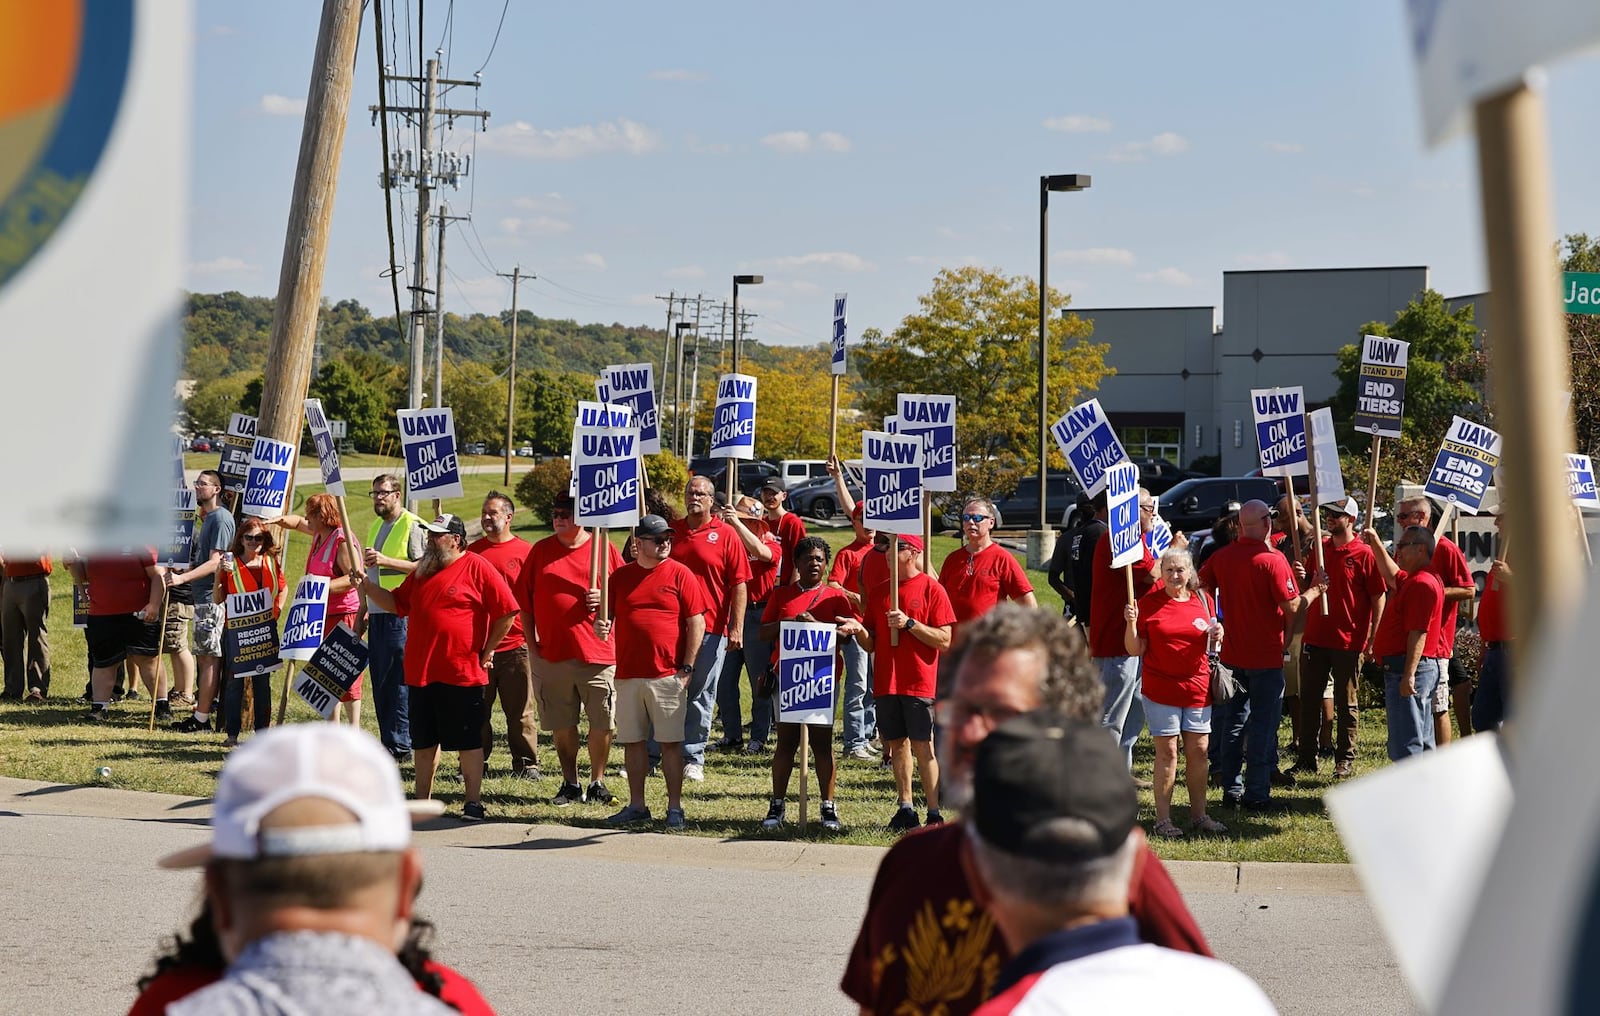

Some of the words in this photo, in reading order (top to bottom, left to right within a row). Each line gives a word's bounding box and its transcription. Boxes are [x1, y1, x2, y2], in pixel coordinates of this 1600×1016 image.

[1369, 340, 1400, 364] UAW
[611, 370, 648, 391] UAW
[1362, 366, 1387, 376] STAND
[719, 380, 752, 399] UAW
[1364, 381, 1395, 398] END
[721, 404, 739, 424] ON
[904, 400, 950, 423] UAW
[1256, 394, 1298, 415] UAW
[1360, 396, 1400, 414] TIERS
[237, 418, 256, 436] UA
[402, 414, 447, 436] UAW
[582, 408, 628, 428] UAW
[1056, 403, 1097, 444] UAW
[711, 418, 752, 448] STRIKE
[1269, 420, 1288, 442] ON
[1458, 422, 1497, 450] UAW
[229, 438, 254, 448] STAN
[254, 440, 292, 466] UAW
[418, 442, 437, 464] ON
[582, 435, 634, 456] UAW
[868, 438, 917, 464] UAW
[1080, 435, 1098, 460] ON
[1261, 432, 1306, 467] STRIKE
[1446, 442, 1479, 458] STAND
[1482, 453, 1494, 464] UP
[230, 450, 252, 464] EN
[1084, 441, 1120, 484] STRIKE
[1446, 456, 1483, 478] END
[222, 461, 247, 476] TIE
[256, 470, 275, 486] ON
[410, 454, 456, 489] STRIKE
[595, 464, 618, 488] ON
[880, 471, 900, 494] ON
[1109, 465, 1136, 497] UAW
[1435, 468, 1484, 494] TIERS
[246, 488, 284, 506] STRIKE
[580, 478, 636, 514] STRIKE
[866, 487, 919, 517] STRIKE
[1118, 502, 1131, 526] ON
[1113, 521, 1141, 554] STRIKE
[295, 581, 325, 600] AW
[234, 592, 265, 614] UAW
[230, 616, 260, 628] STAND
[263, 612, 272, 621] UP
[292, 606, 308, 626] ON
[238, 626, 270, 639] RECORD
[238, 633, 272, 646] PROFITS
[280, 620, 323, 648] STRIKE
[784, 629, 831, 652] UAW
[240, 642, 272, 655] RECORD
[332, 641, 360, 664] DREAM
[306, 666, 318, 675] UP
[320, 657, 348, 682] SAVING
[321, 644, 360, 676] AMERICAN
[792, 659, 814, 683] ON
[298, 678, 331, 712] UAW
[318, 674, 344, 696] STAND
[781, 675, 832, 710] STRIKE
